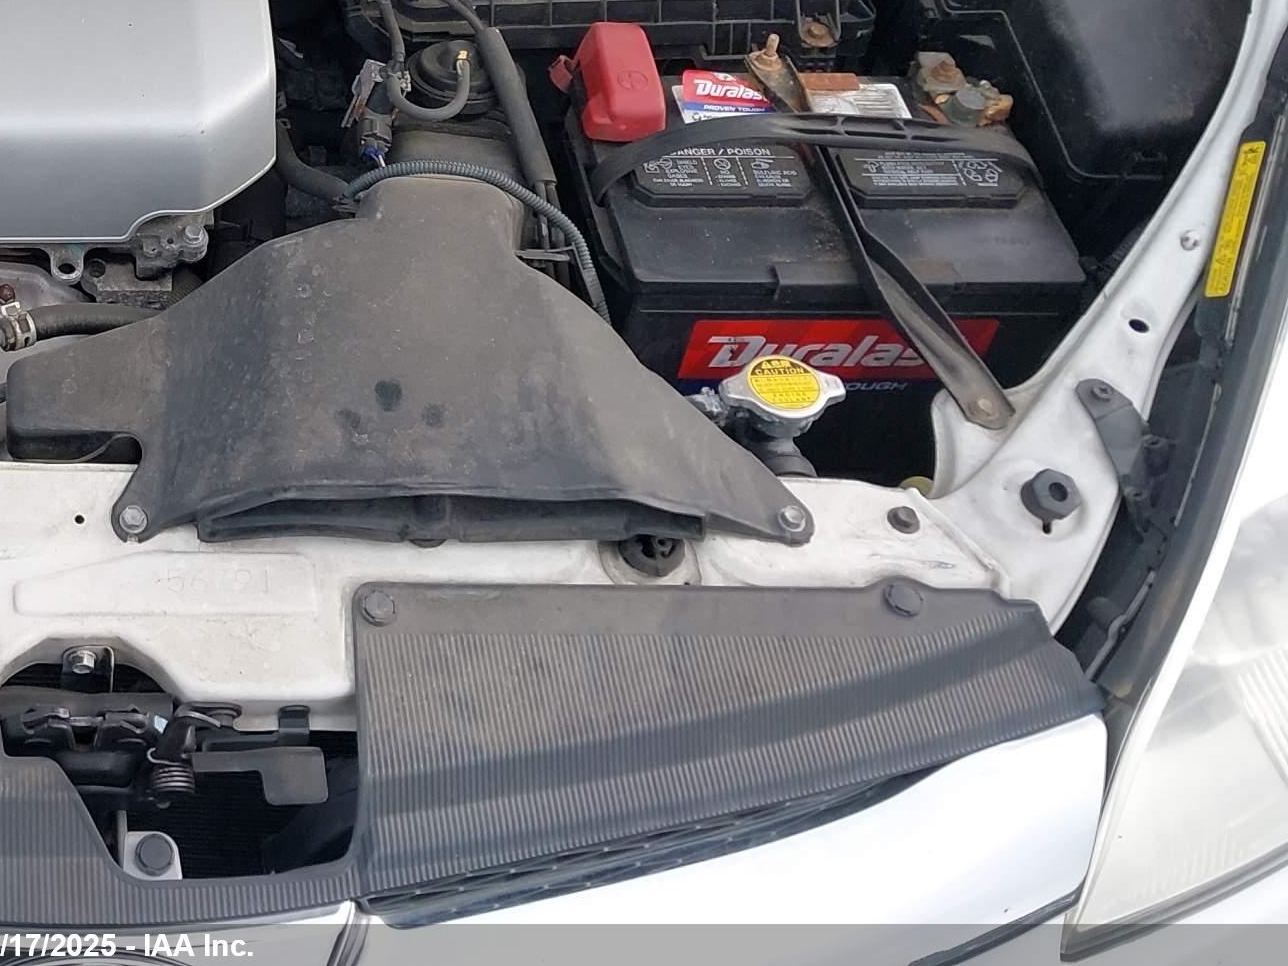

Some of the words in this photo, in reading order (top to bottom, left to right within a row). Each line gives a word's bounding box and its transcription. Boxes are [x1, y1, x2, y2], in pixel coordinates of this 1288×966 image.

[694, 79, 769, 103] Duralas
[703, 104, 735, 112] PROVEN
[727, 148, 771, 156] POISON
[708, 335, 924, 368] Duralas
[755, 368, 805, 376] CAUTION
[845, 381, 908, 391] OUGH
